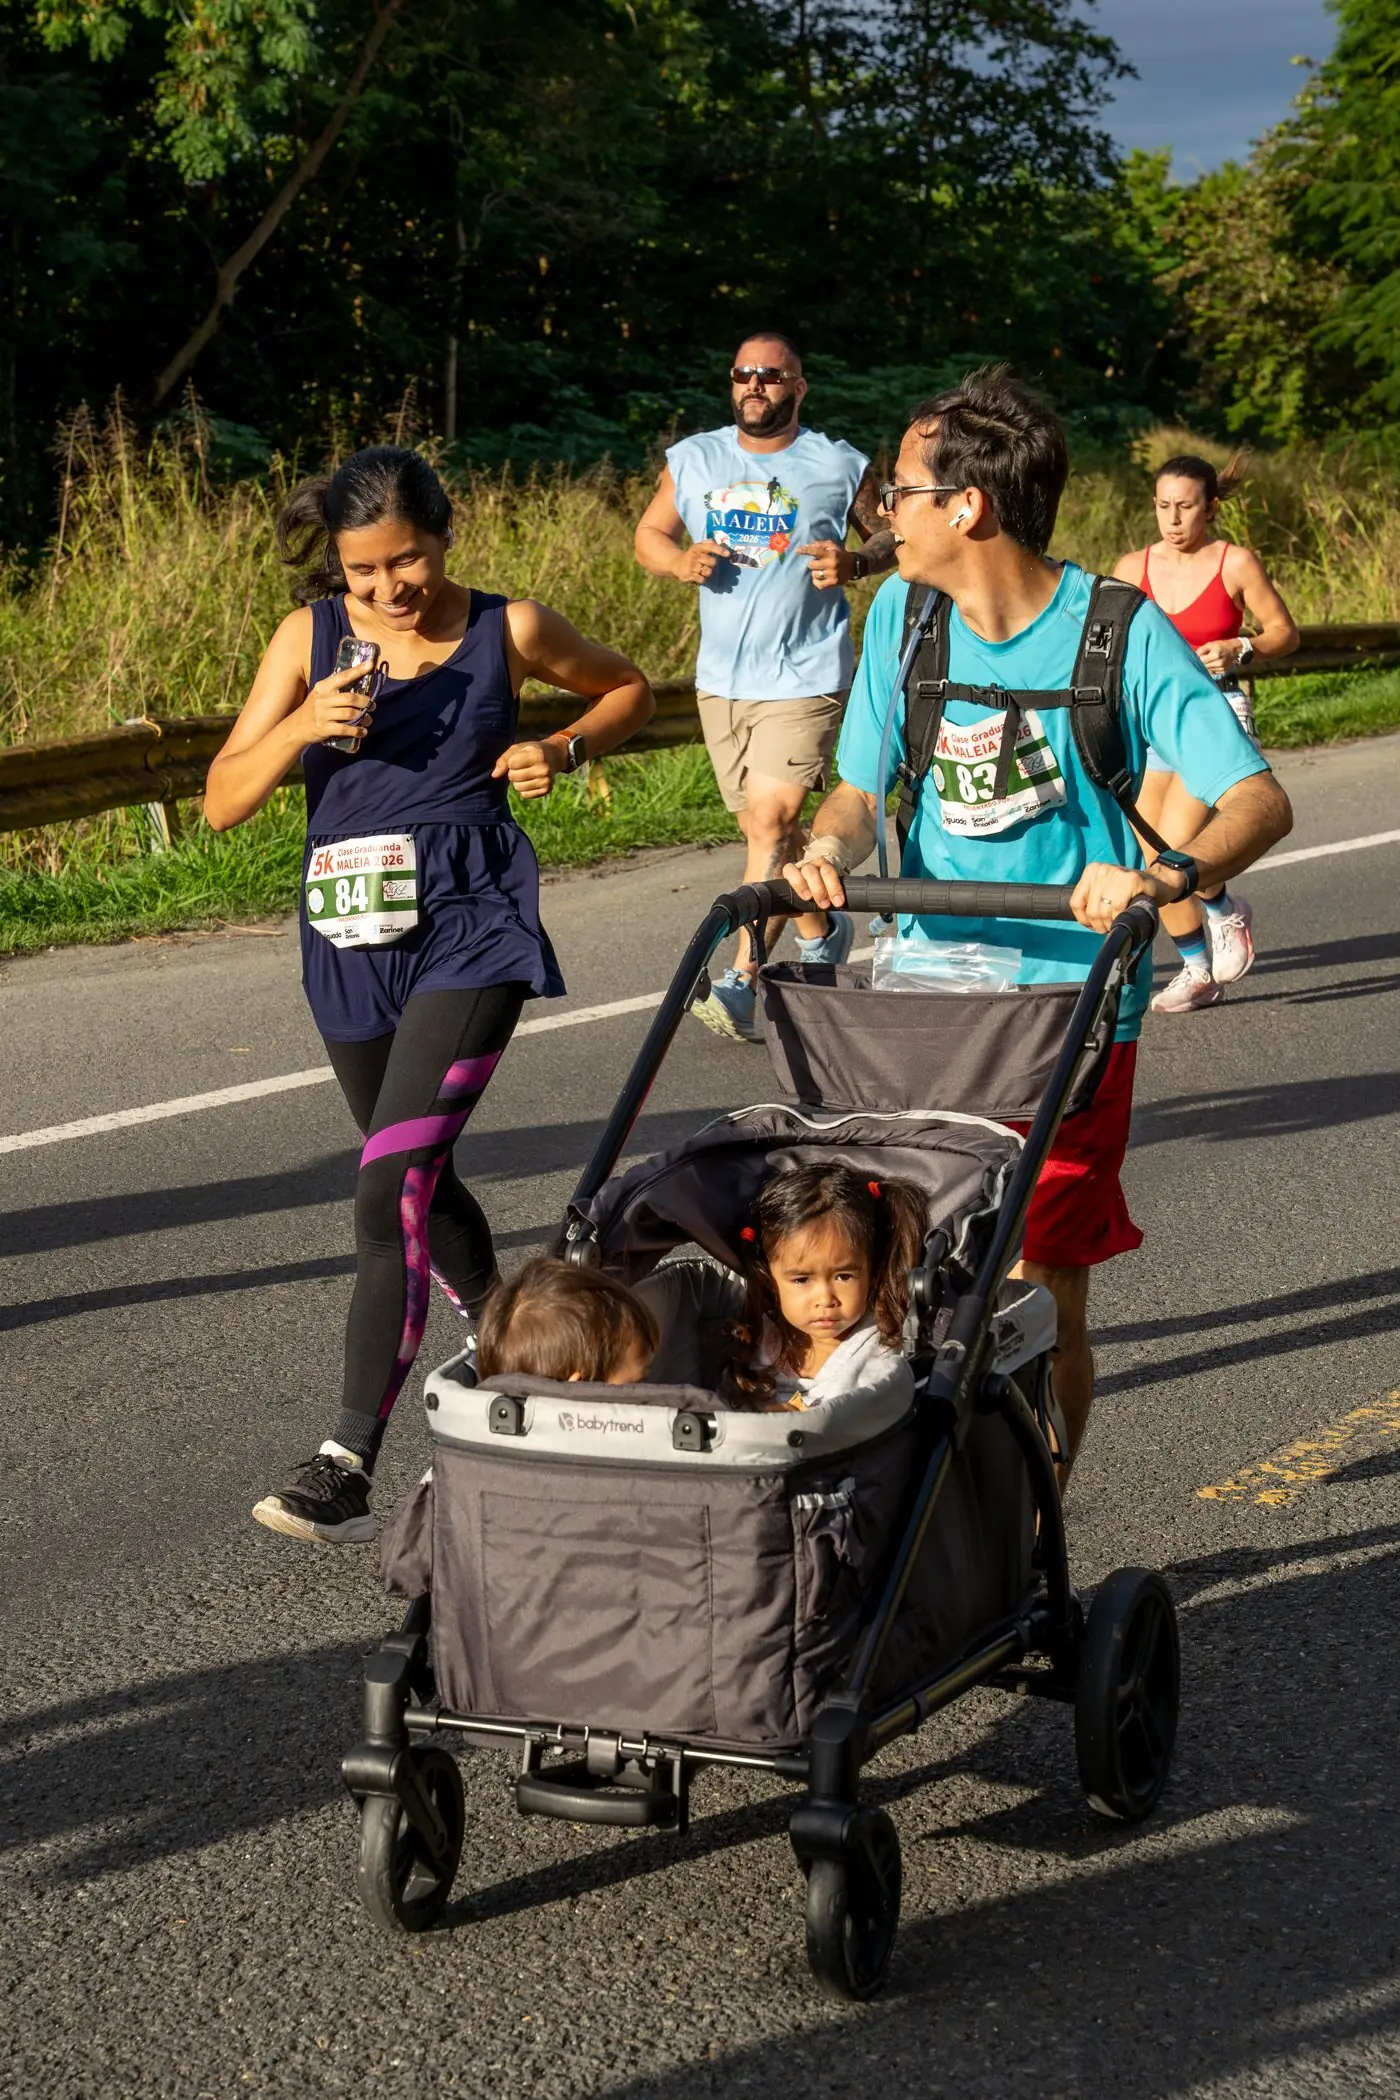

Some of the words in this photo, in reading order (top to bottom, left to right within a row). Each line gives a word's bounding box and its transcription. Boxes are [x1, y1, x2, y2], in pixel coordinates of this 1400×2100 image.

[711, 512, 790, 532] MALEIA
[738, 534, 759, 543] 2026
[951, 732, 970, 744] Clase
[953, 740, 998, 759] MALEIA
[956, 762, 998, 804] 83
[337, 848, 354, 858] Clase
[354, 843, 401, 854] Graduanda
[313, 849, 335, 877] 5k
[337, 858, 370, 871] MALEIA
[374, 855, 404, 866] 2026
[335, 876, 368, 915] 84
[379, 925, 404, 934] Zarinet
[577, 1412, 645, 1435] babytrend
